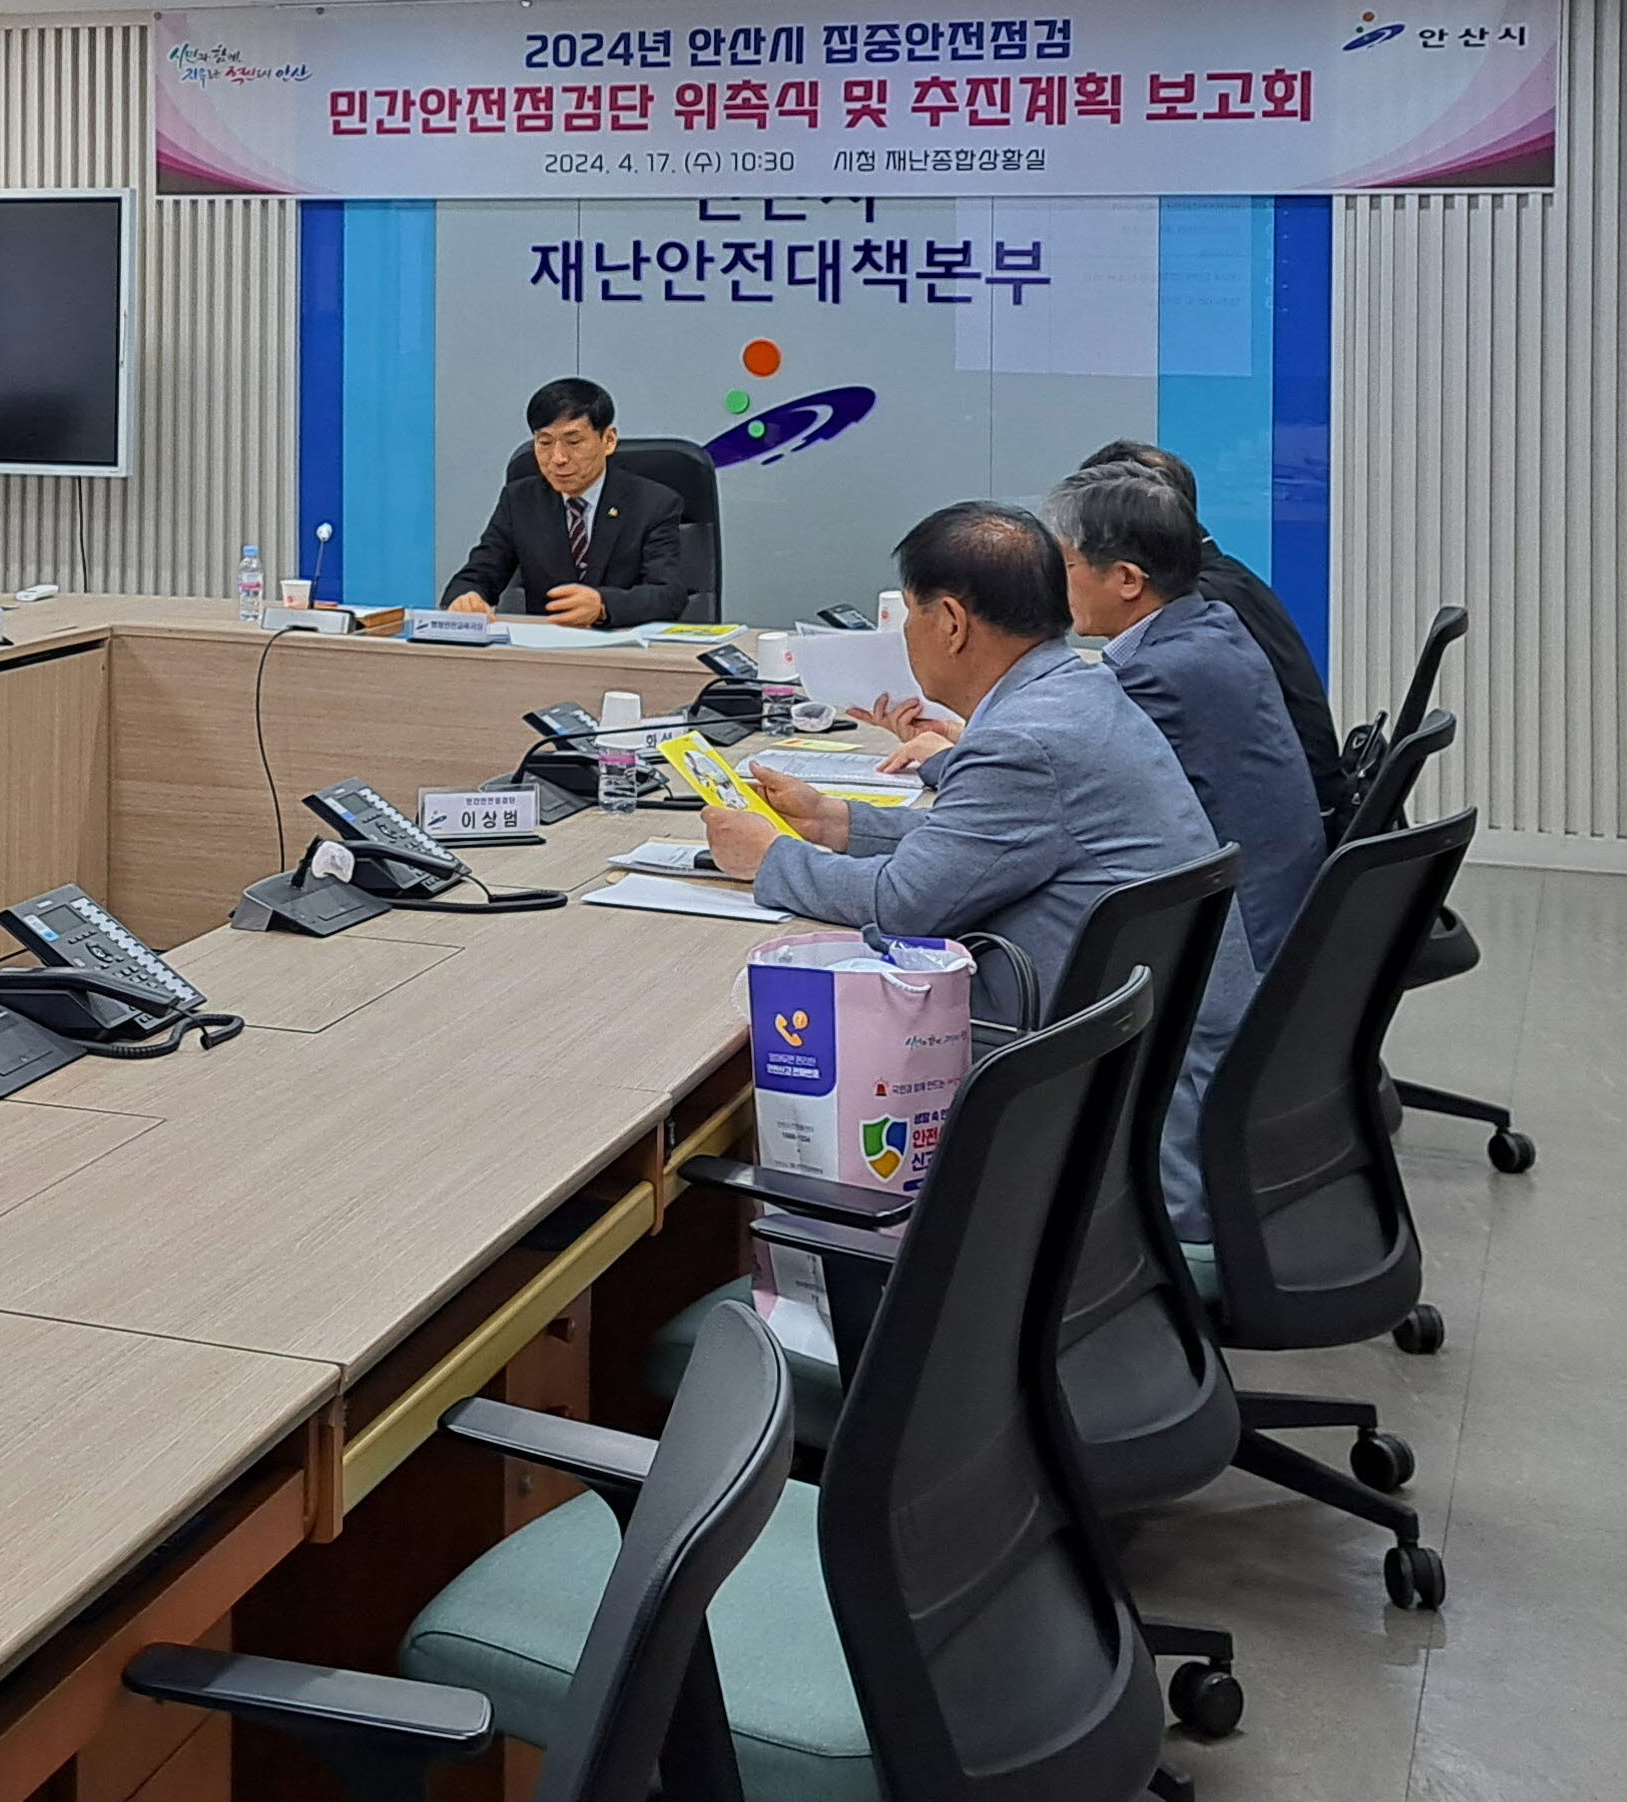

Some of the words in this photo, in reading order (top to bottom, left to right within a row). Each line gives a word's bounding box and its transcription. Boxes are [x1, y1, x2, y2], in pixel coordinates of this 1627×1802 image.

[525, 30, 672, 69] 2024년
[688, 25, 805, 67] 안산시
[822, 19, 1072, 64] 집중안전점검
[1418, 25, 1526, 48] 안산시
[275, 64, 313, 82] 안산
[329, 84, 655, 136] 민간안전점검단
[674, 79, 819, 131] 위촉식
[843, 79, 888, 129] 및
[910, 72, 1122, 128] 추진계획
[1145, 68, 1312, 123] 보고회
[544, 153, 610, 175] 2024.
[618, 153, 639, 175] 4.
[646, 152, 676, 175] 17.
[684, 151, 722, 175] (수)
[730, 151, 795, 173] 10:30
[832, 149, 876, 173] 시청
[885, 148, 1046, 172] 재난종합상황실
[530, 239, 1052, 306] 재난안전대책본부
[461, 810, 518, 830] 이상범
[912, 1127, 939, 1149] 안전
